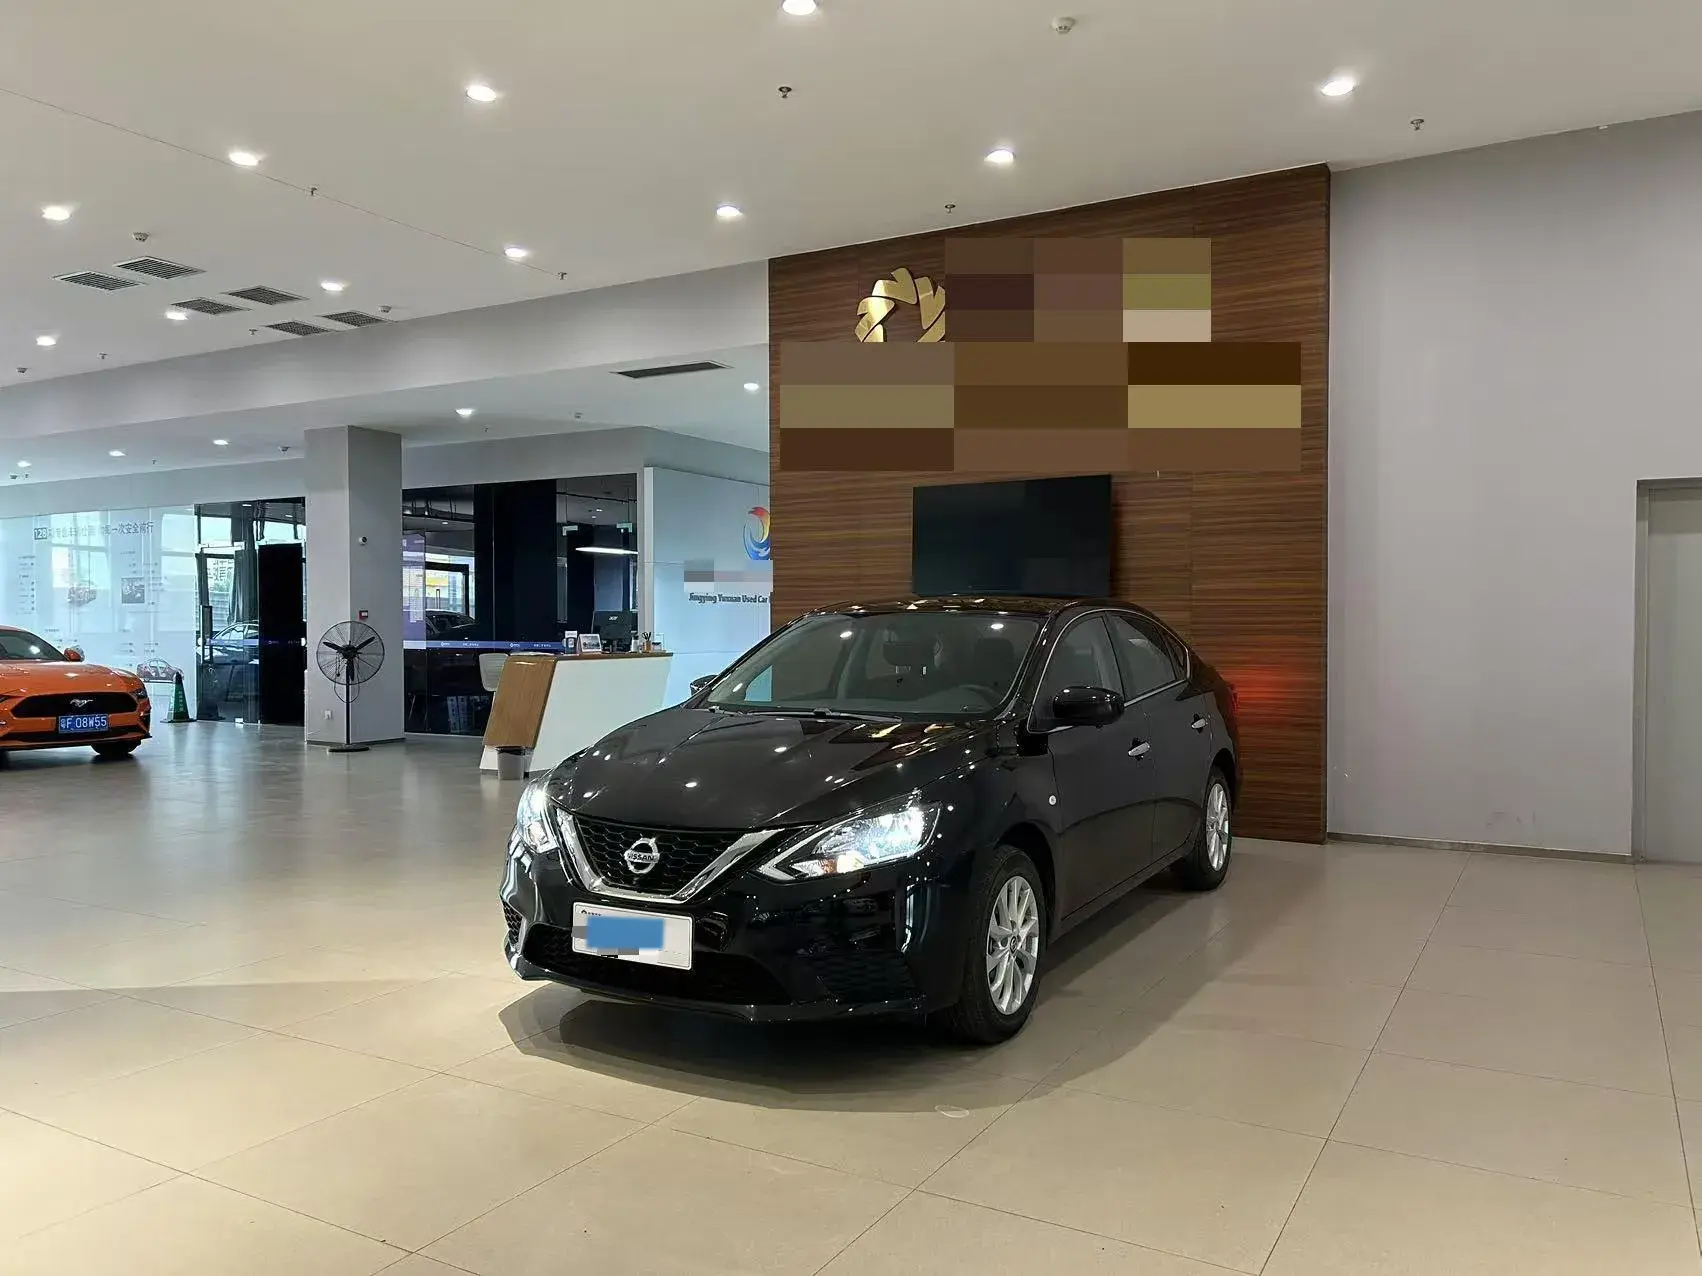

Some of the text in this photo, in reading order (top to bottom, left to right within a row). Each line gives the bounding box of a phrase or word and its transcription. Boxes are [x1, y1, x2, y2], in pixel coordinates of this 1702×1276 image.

[742, 594, 758, 603] Used
[758, 595, 768, 603] Car
[627, 852, 655, 861] NISSAN
